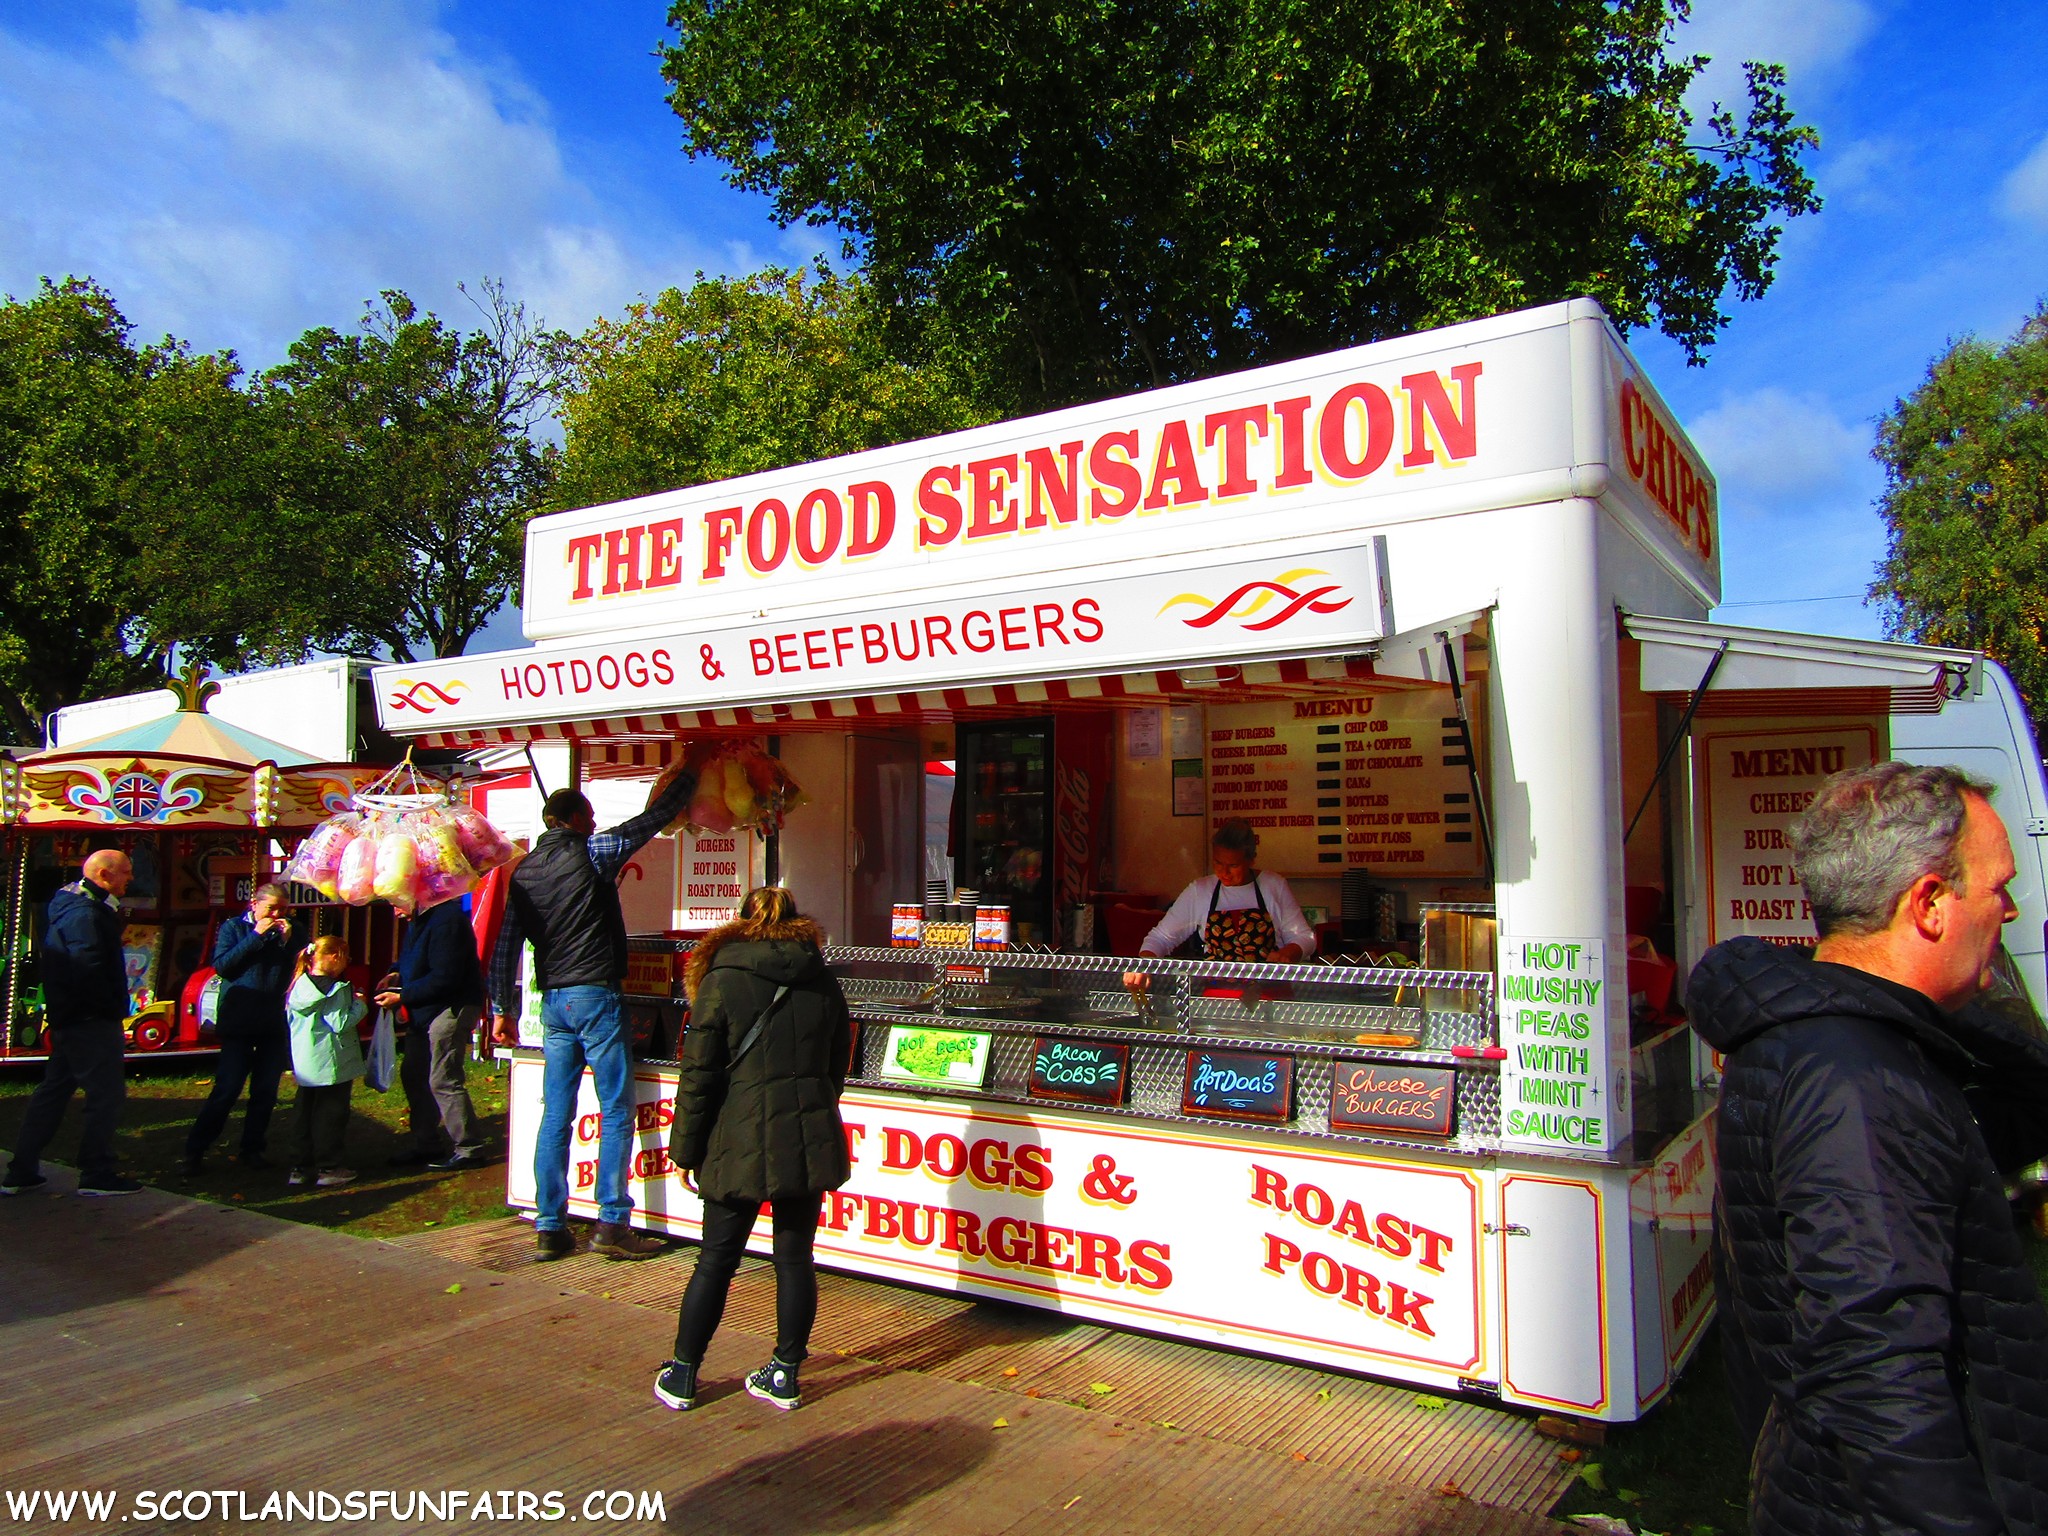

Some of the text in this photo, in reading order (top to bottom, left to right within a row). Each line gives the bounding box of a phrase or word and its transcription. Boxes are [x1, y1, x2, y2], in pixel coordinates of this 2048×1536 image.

[1620, 377, 1711, 559] CHIPS
[568, 362, 1483, 602] THE FOOD SENSATION
[502, 598, 1104, 700] HOTDOGS & BEEFBURGERS
[1294, 697, 1374, 717] MENU
[1211, 727, 1275, 741] BEEF BURGERS
[1345, 720, 1388, 734] CHIP COB
[1212, 744, 1287, 758] CHEESE BURGERS
[1345, 740, 1364, 752] TEA
[1374, 737, 1411, 750] COFFEE
[1212, 765, 1229, 776] HOT
[1231, 763, 1254, 775] DOGS
[1346, 755, 1423, 770] HOT CHOCOLATE
[1731, 746, 1845, 778] MENU
[1212, 779, 1288, 793] JUMBO HOT DOGS
[1213, 797, 1287, 811] HOT ROAST PORK
[1346, 794, 1389, 807] BOTTLES
[1750, 791, 1814, 814] CHEES
[1246, 816, 1277, 827] HEESE
[1279, 815, 1315, 827] BURGER
[1347, 812, 1440, 825] BOTTLES OF WATER
[695, 838, 735, 852] BURGERS
[1347, 831, 1412, 844] CANDY FLOSS
[1347, 850, 1425, 862] TOFFEE APPLES
[693, 861, 736, 875] HOT DOGS
[1742, 865, 1783, 885] HOT
[687, 884, 741, 897] ROAST PORK
[689, 906, 730, 920] STUFFING
[1731, 899, 1795, 920] ROAST
[927, 928, 967, 943] CHIPS
[1523, 943, 1582, 971] HOT
[1504, 975, 1602, 1006] MUSHY
[1516, 1009, 1590, 1039] PEAS
[1051, 1043, 1102, 1063] BACON
[1517, 1043, 1590, 1075] WITH
[1046, 1062, 1096, 1085] COBS
[1350, 1069, 1430, 1095] Cheese
[1519, 1077, 1587, 1109] MINT
[1345, 1096, 1436, 1119] BURGERS
[1507, 1109, 1602, 1145] SAUCE
[881, 1126, 1053, 1191] DOGS
[1082, 1154, 1138, 1206] &
[1250, 1163, 1453, 1273] ROAST
[1263, 1231, 1436, 1337] PORK
